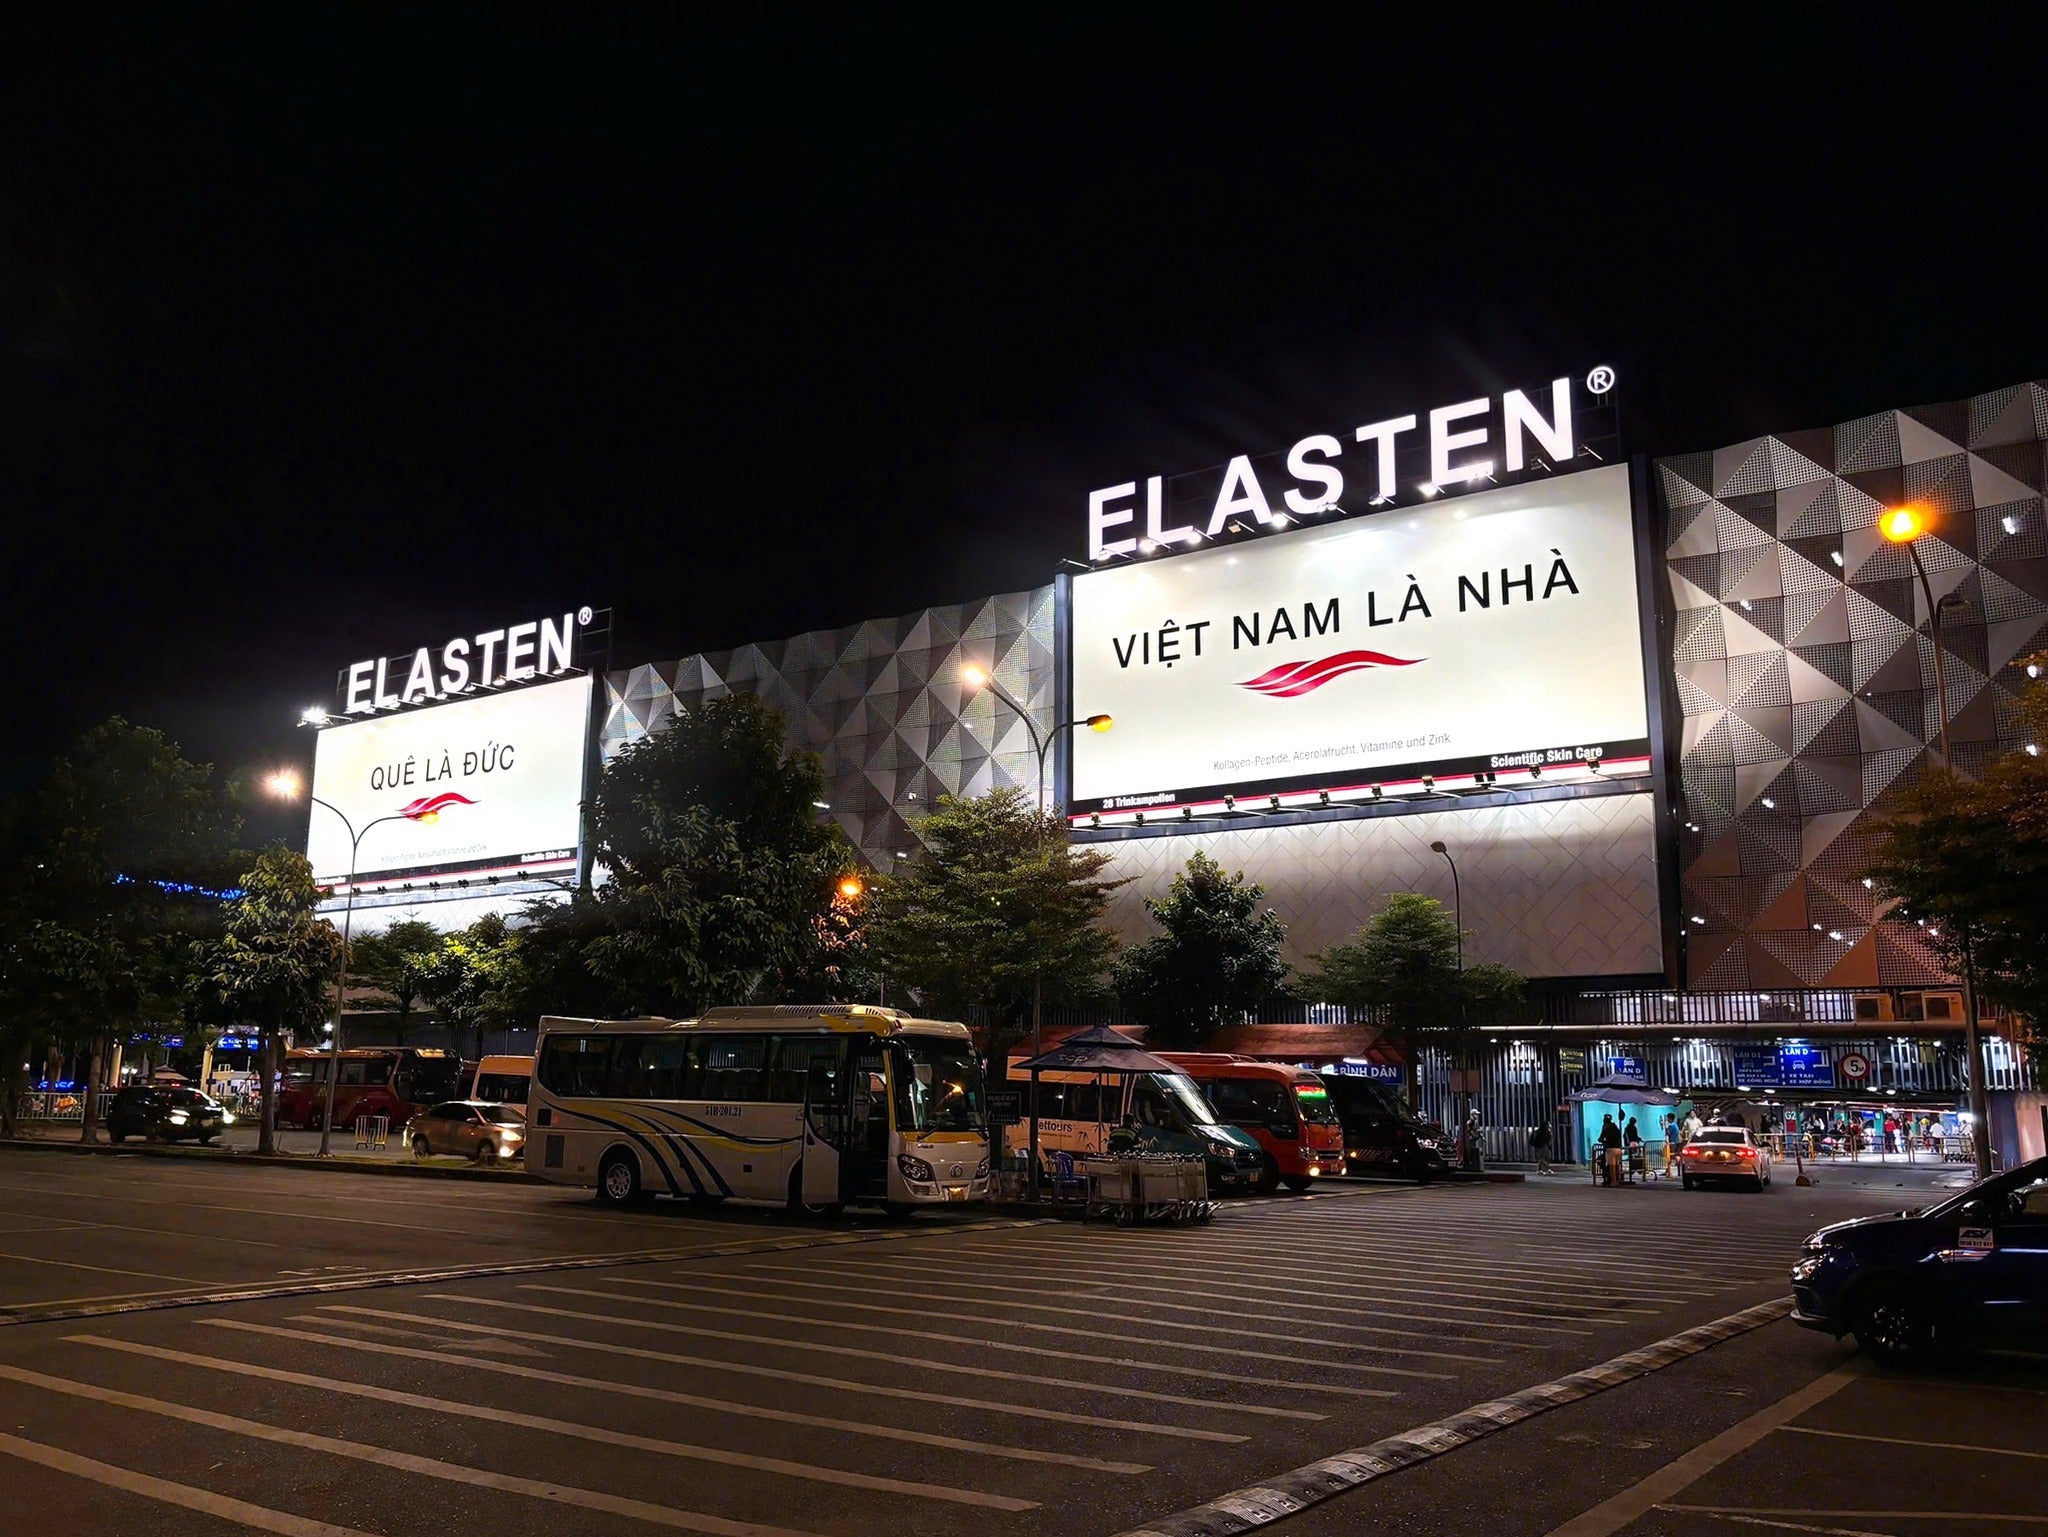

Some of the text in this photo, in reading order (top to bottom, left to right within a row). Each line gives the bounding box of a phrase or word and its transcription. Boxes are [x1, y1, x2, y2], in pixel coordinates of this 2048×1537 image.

[1113, 548, 1580, 669] VIỆT NAM LÀ NHÀ
[1360, 739, 1404, 753] Vitamine
[1406, 736, 1426, 748] und
[1429, 733, 1451, 746] Zink
[370, 741, 515, 791] QUÊ LÀ ĐỨC
[1491, 747, 1603, 768] Scientific Skin Care
[1102, 798, 1114, 809] 28
[1371, 1064, 1397, 1078] DÂN
[1784, 1110, 1797, 1120] G2
[1039, 1120, 1073, 1132] ettours
